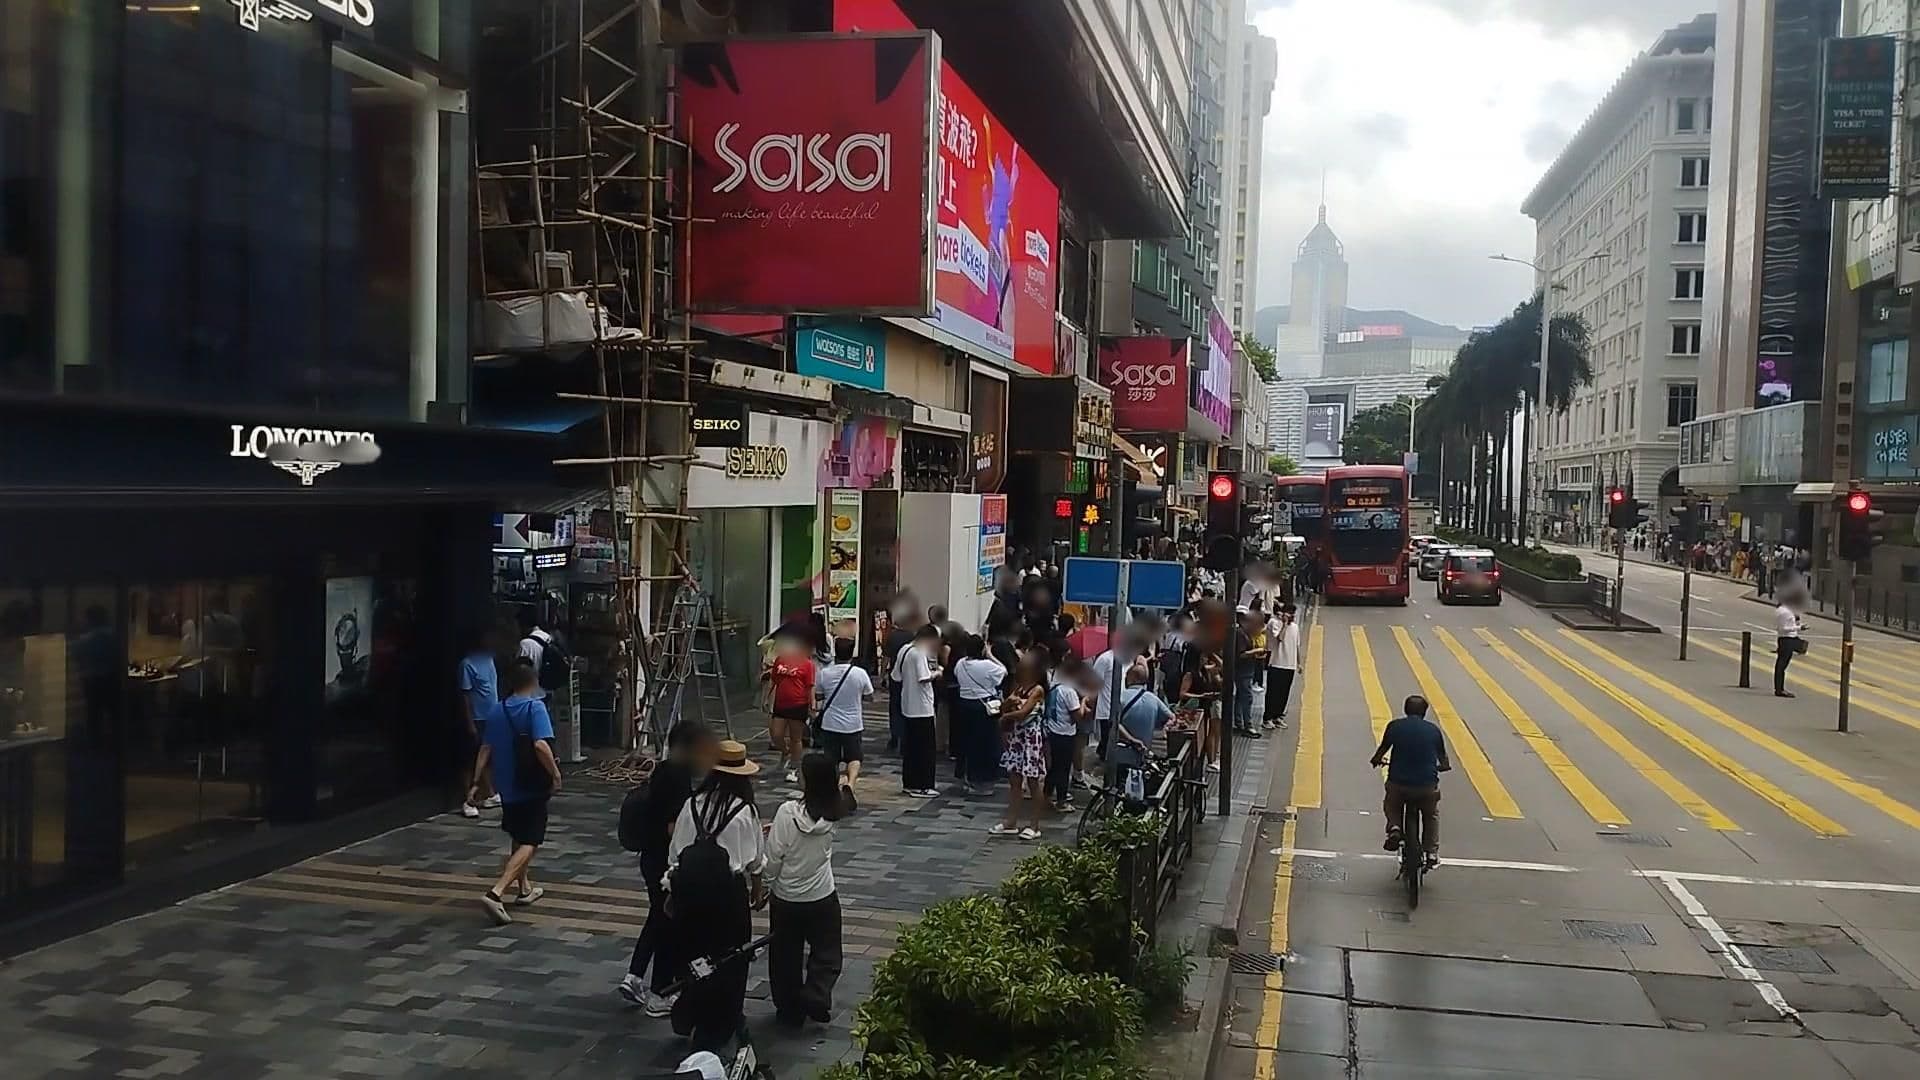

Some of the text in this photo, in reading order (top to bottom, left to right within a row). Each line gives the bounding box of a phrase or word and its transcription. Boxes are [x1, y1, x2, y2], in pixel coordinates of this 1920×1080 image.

[777, 201, 807, 228] life
[810, 201, 880, 228] beautiful
[960, 233, 986, 284] tickets
[1128, 387, 1157, 402] 莎莎
[693, 418, 741, 431] SEIKO
[727, 445, 788, 477] SEIKO
